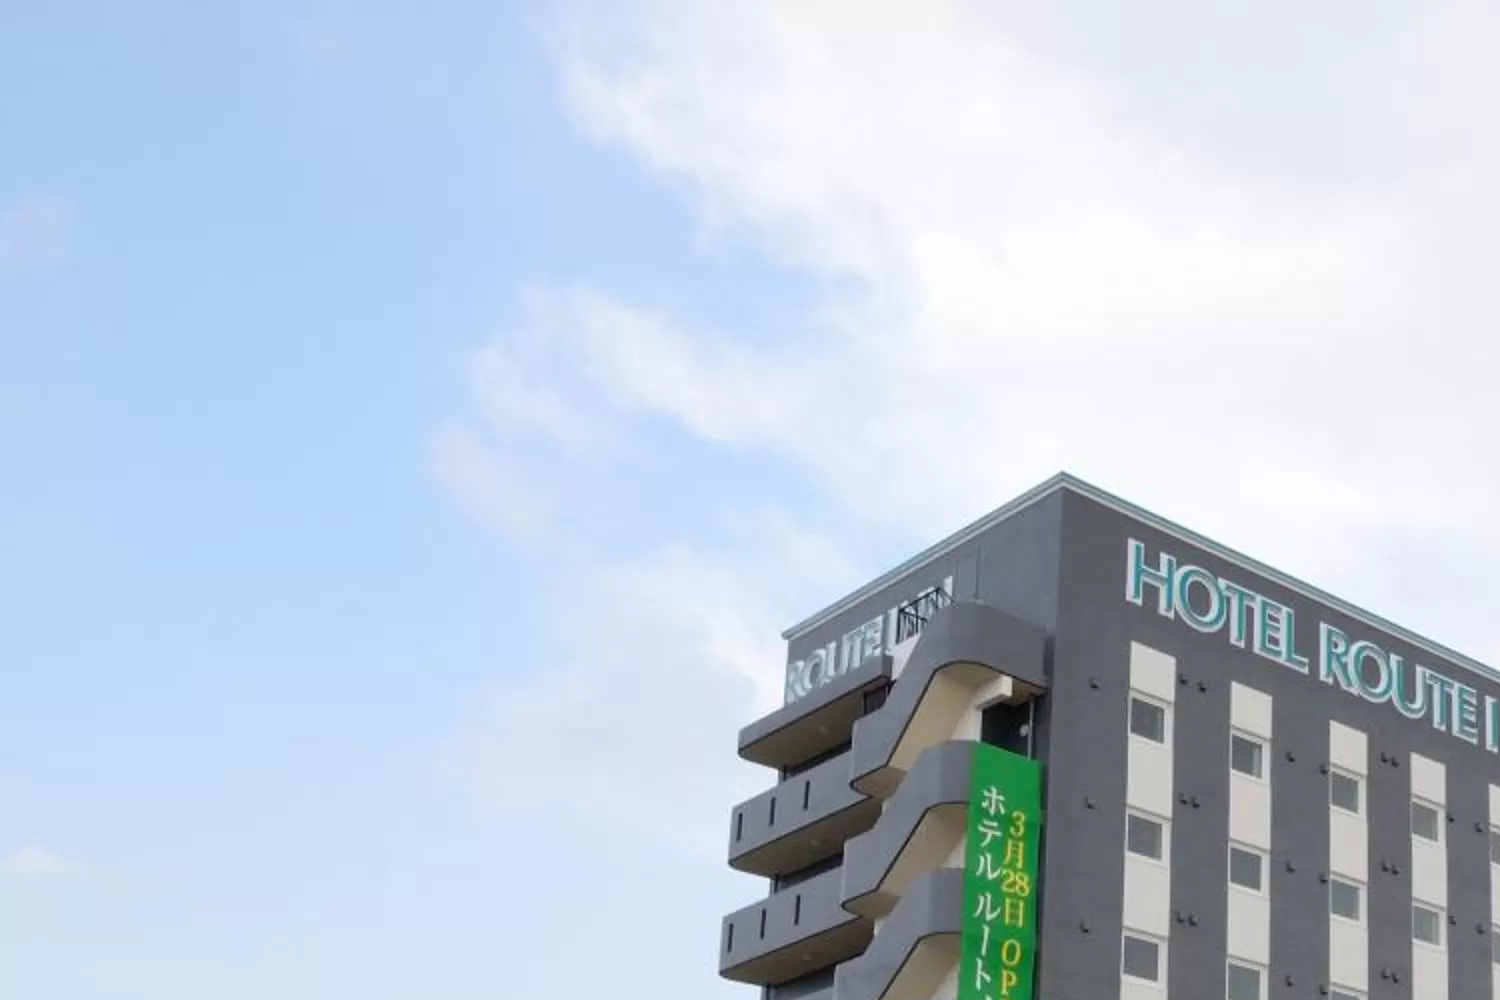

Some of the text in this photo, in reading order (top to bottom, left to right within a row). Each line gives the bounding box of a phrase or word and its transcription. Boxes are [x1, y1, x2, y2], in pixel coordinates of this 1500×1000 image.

[785, 614, 883, 704] ROUTE
[1126, 537, 1308, 674] HOTEL
[1319, 620, 1478, 745] ROUTE
[1001, 811, 1030, 928] 3月28日
